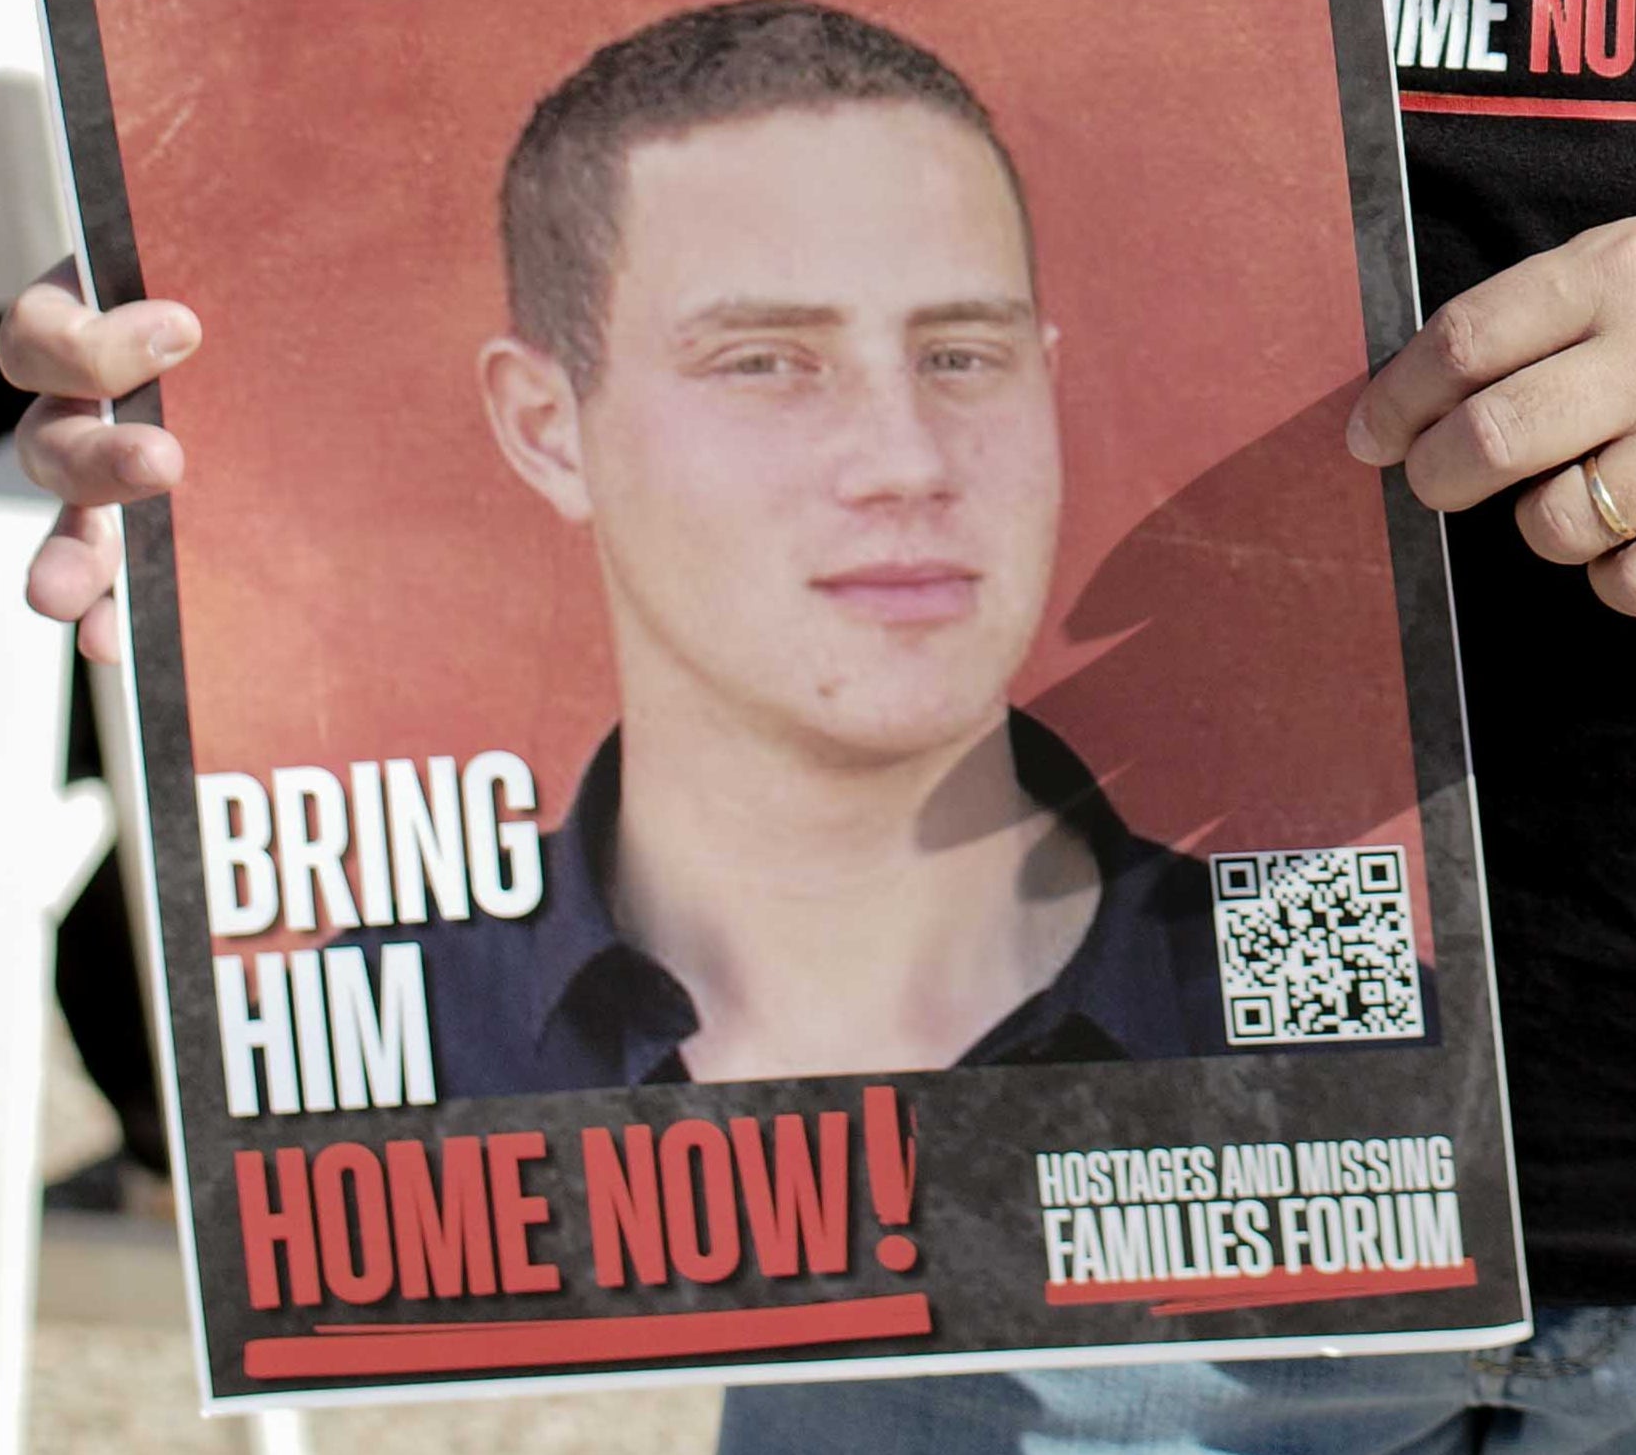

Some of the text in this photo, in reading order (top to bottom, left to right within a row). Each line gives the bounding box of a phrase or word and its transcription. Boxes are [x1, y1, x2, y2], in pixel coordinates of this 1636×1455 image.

[195, 750, 544, 936] BRING
[213, 941, 436, 1118] HIM
[234, 1086, 918, 1309] HOME NOW!
[1036, 1135, 1456, 1206] HOSTAGES AND MISSING
[1043, 1191, 1464, 1285] FAMILIES FORUM
